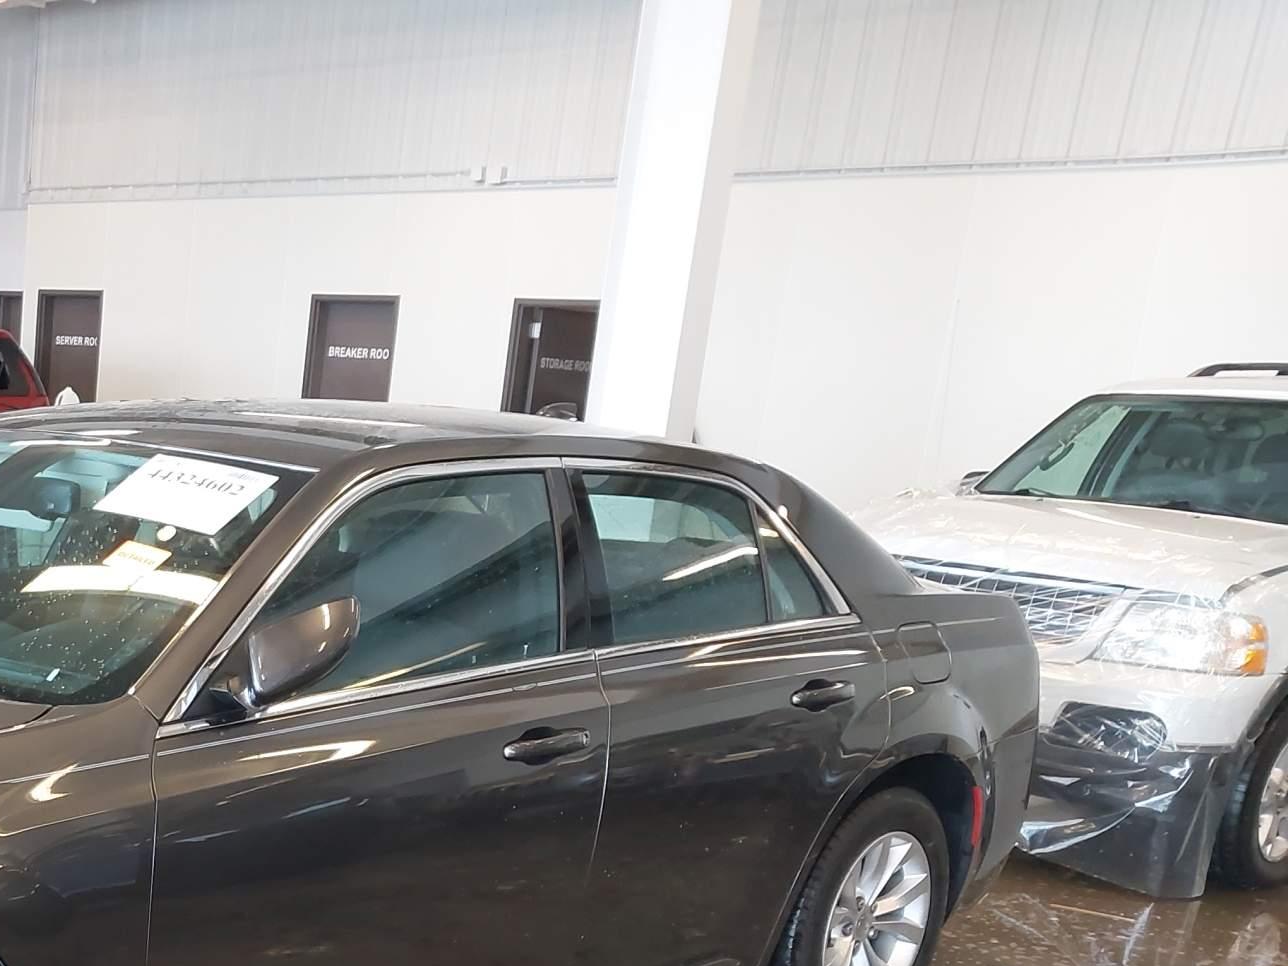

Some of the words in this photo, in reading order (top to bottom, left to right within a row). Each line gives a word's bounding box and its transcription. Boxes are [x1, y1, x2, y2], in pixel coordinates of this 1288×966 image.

[55, 335, 83, 346] SERVER
[328, 345, 369, 359] BREAKER
[540, 357, 574, 371] STORAGE
[148, 468, 246, 497] 44324602
